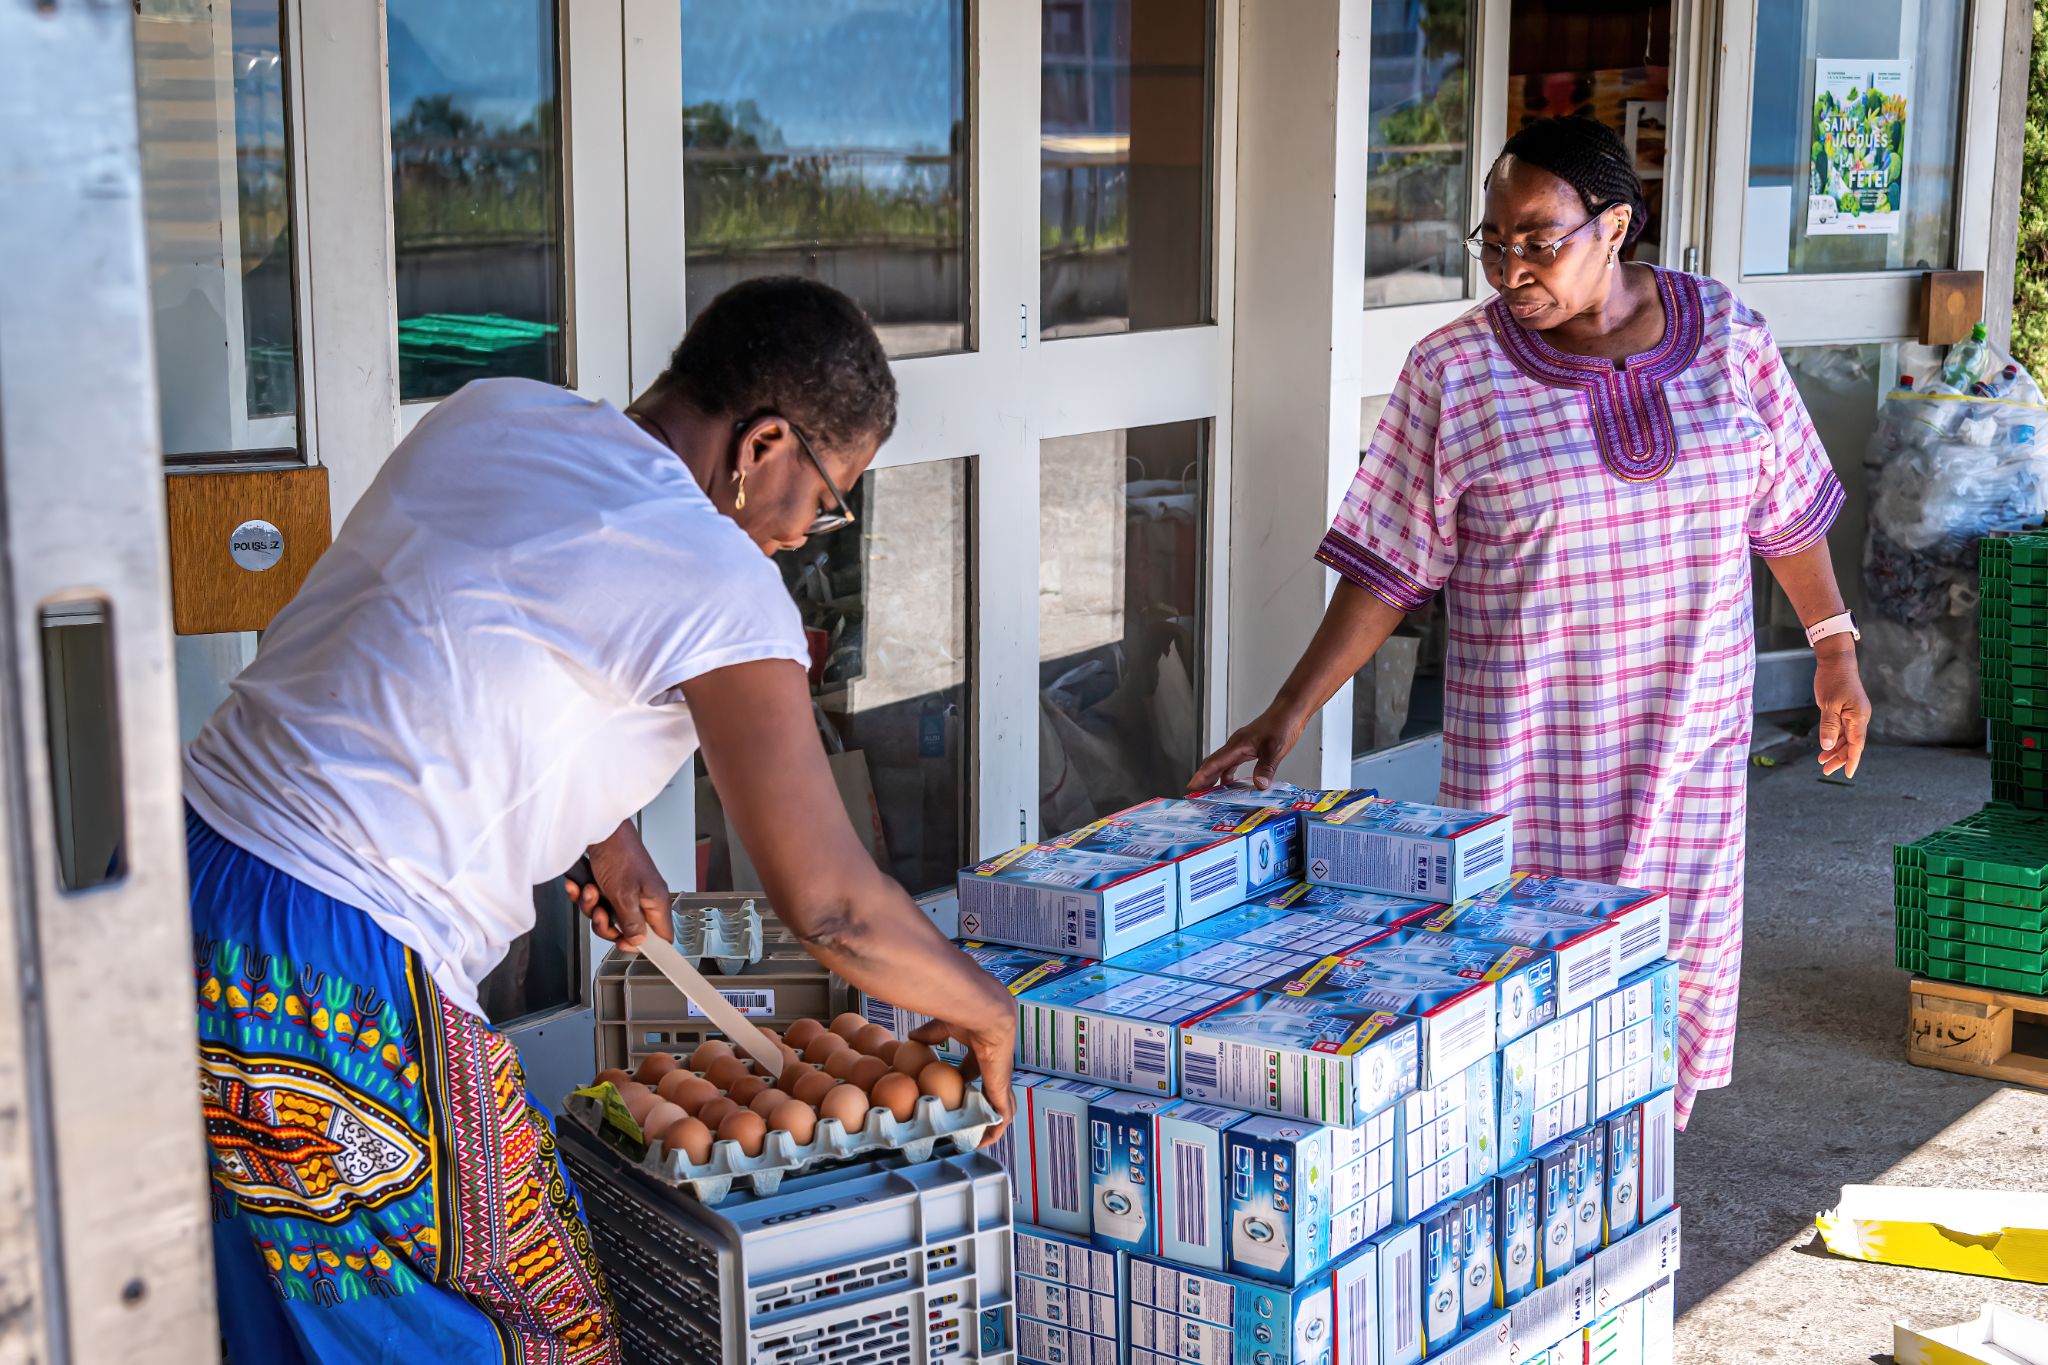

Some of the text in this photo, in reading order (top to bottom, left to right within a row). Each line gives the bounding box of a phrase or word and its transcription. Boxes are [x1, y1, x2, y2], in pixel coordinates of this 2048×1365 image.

[1824, 117, 1864, 132] SAINT-
[1832, 133, 1888, 149] JACQUES
[1839, 153, 1853, 168] LA
